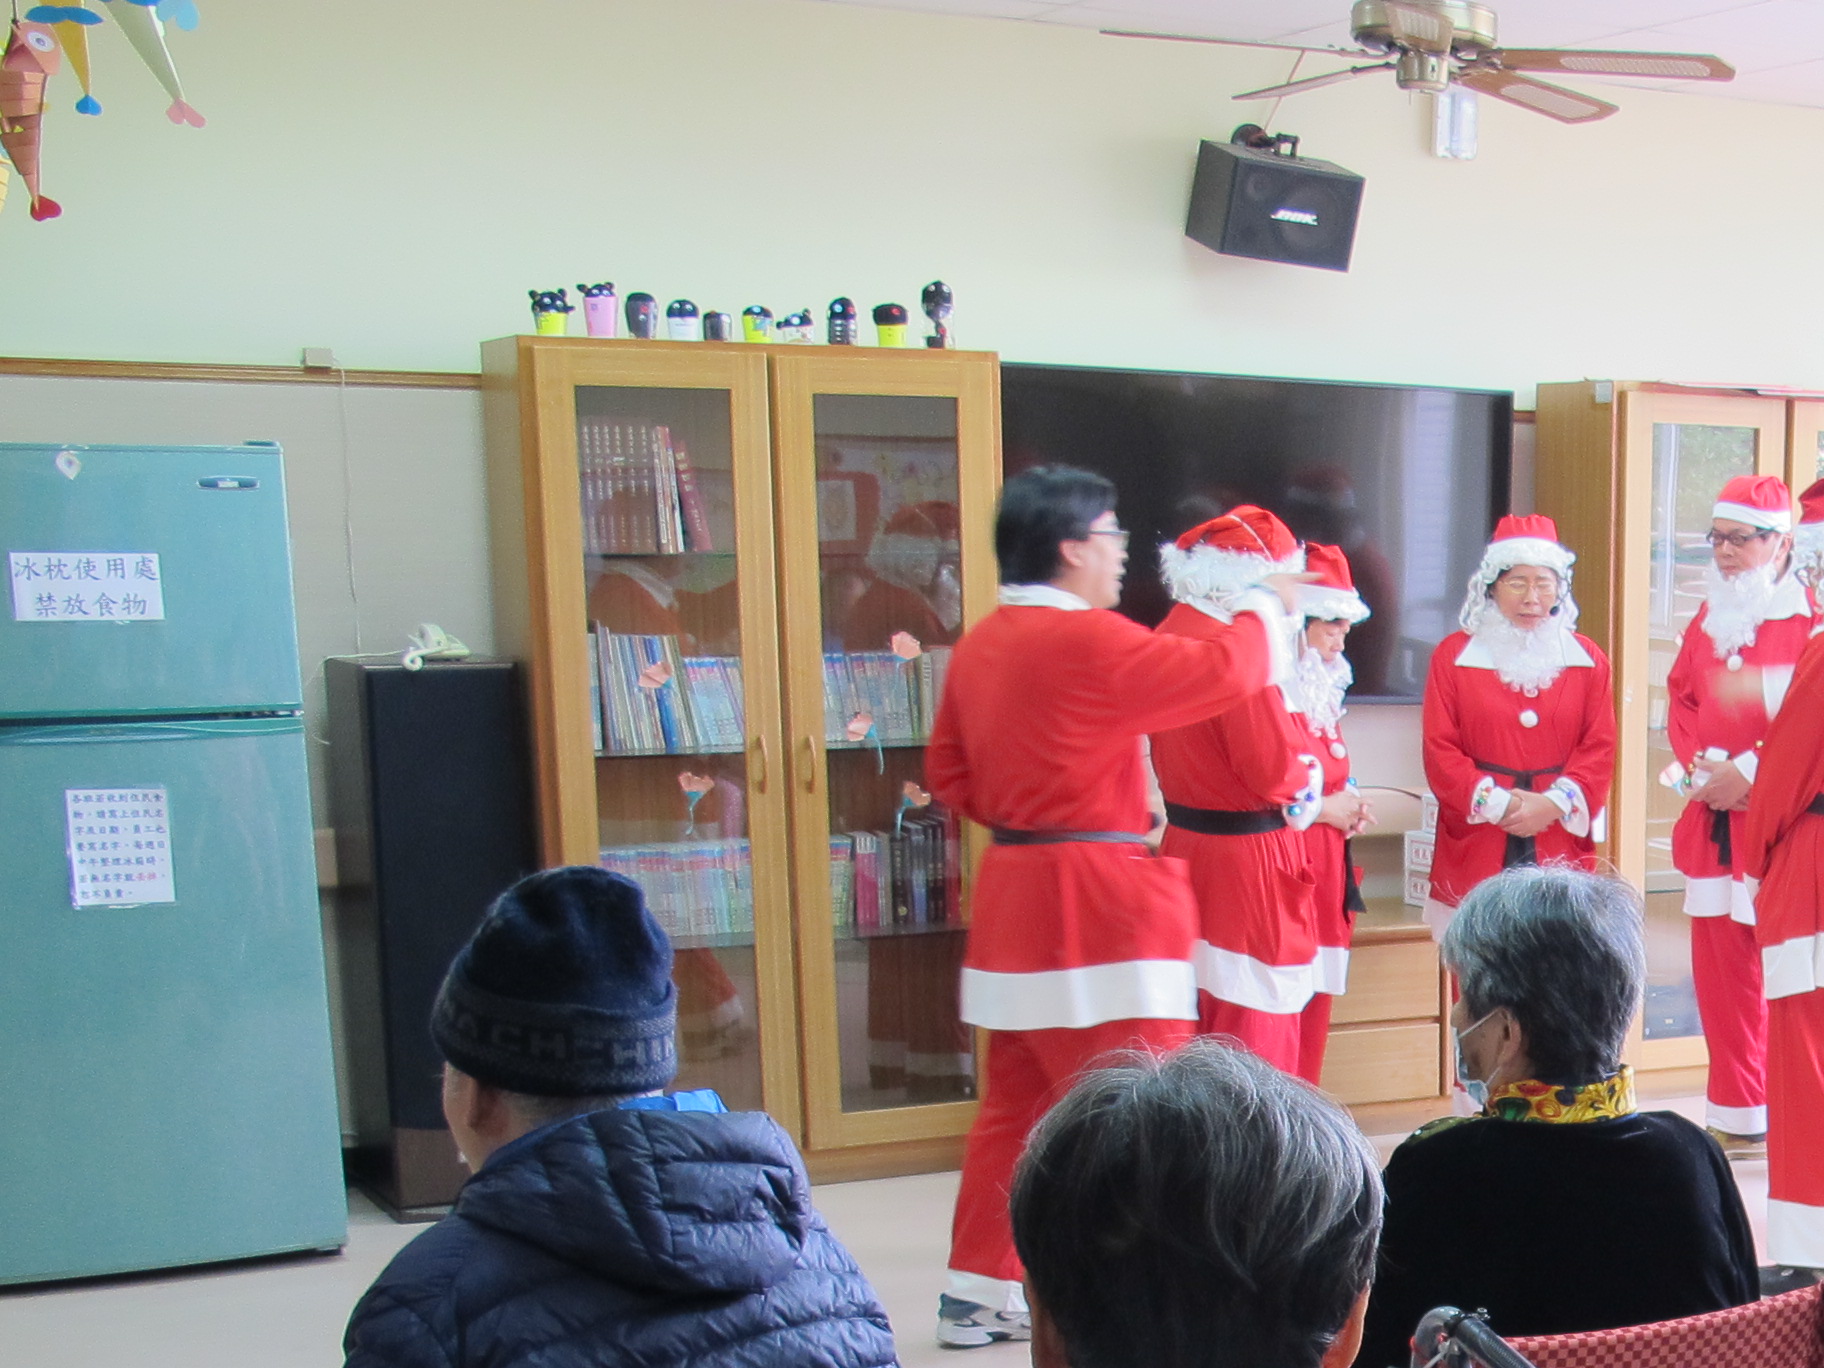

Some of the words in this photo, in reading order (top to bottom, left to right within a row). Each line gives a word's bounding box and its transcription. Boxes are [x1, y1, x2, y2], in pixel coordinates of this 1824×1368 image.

[14, 555, 159, 581] 冰枕使用處
[35, 592, 147, 618] 禁放食物
